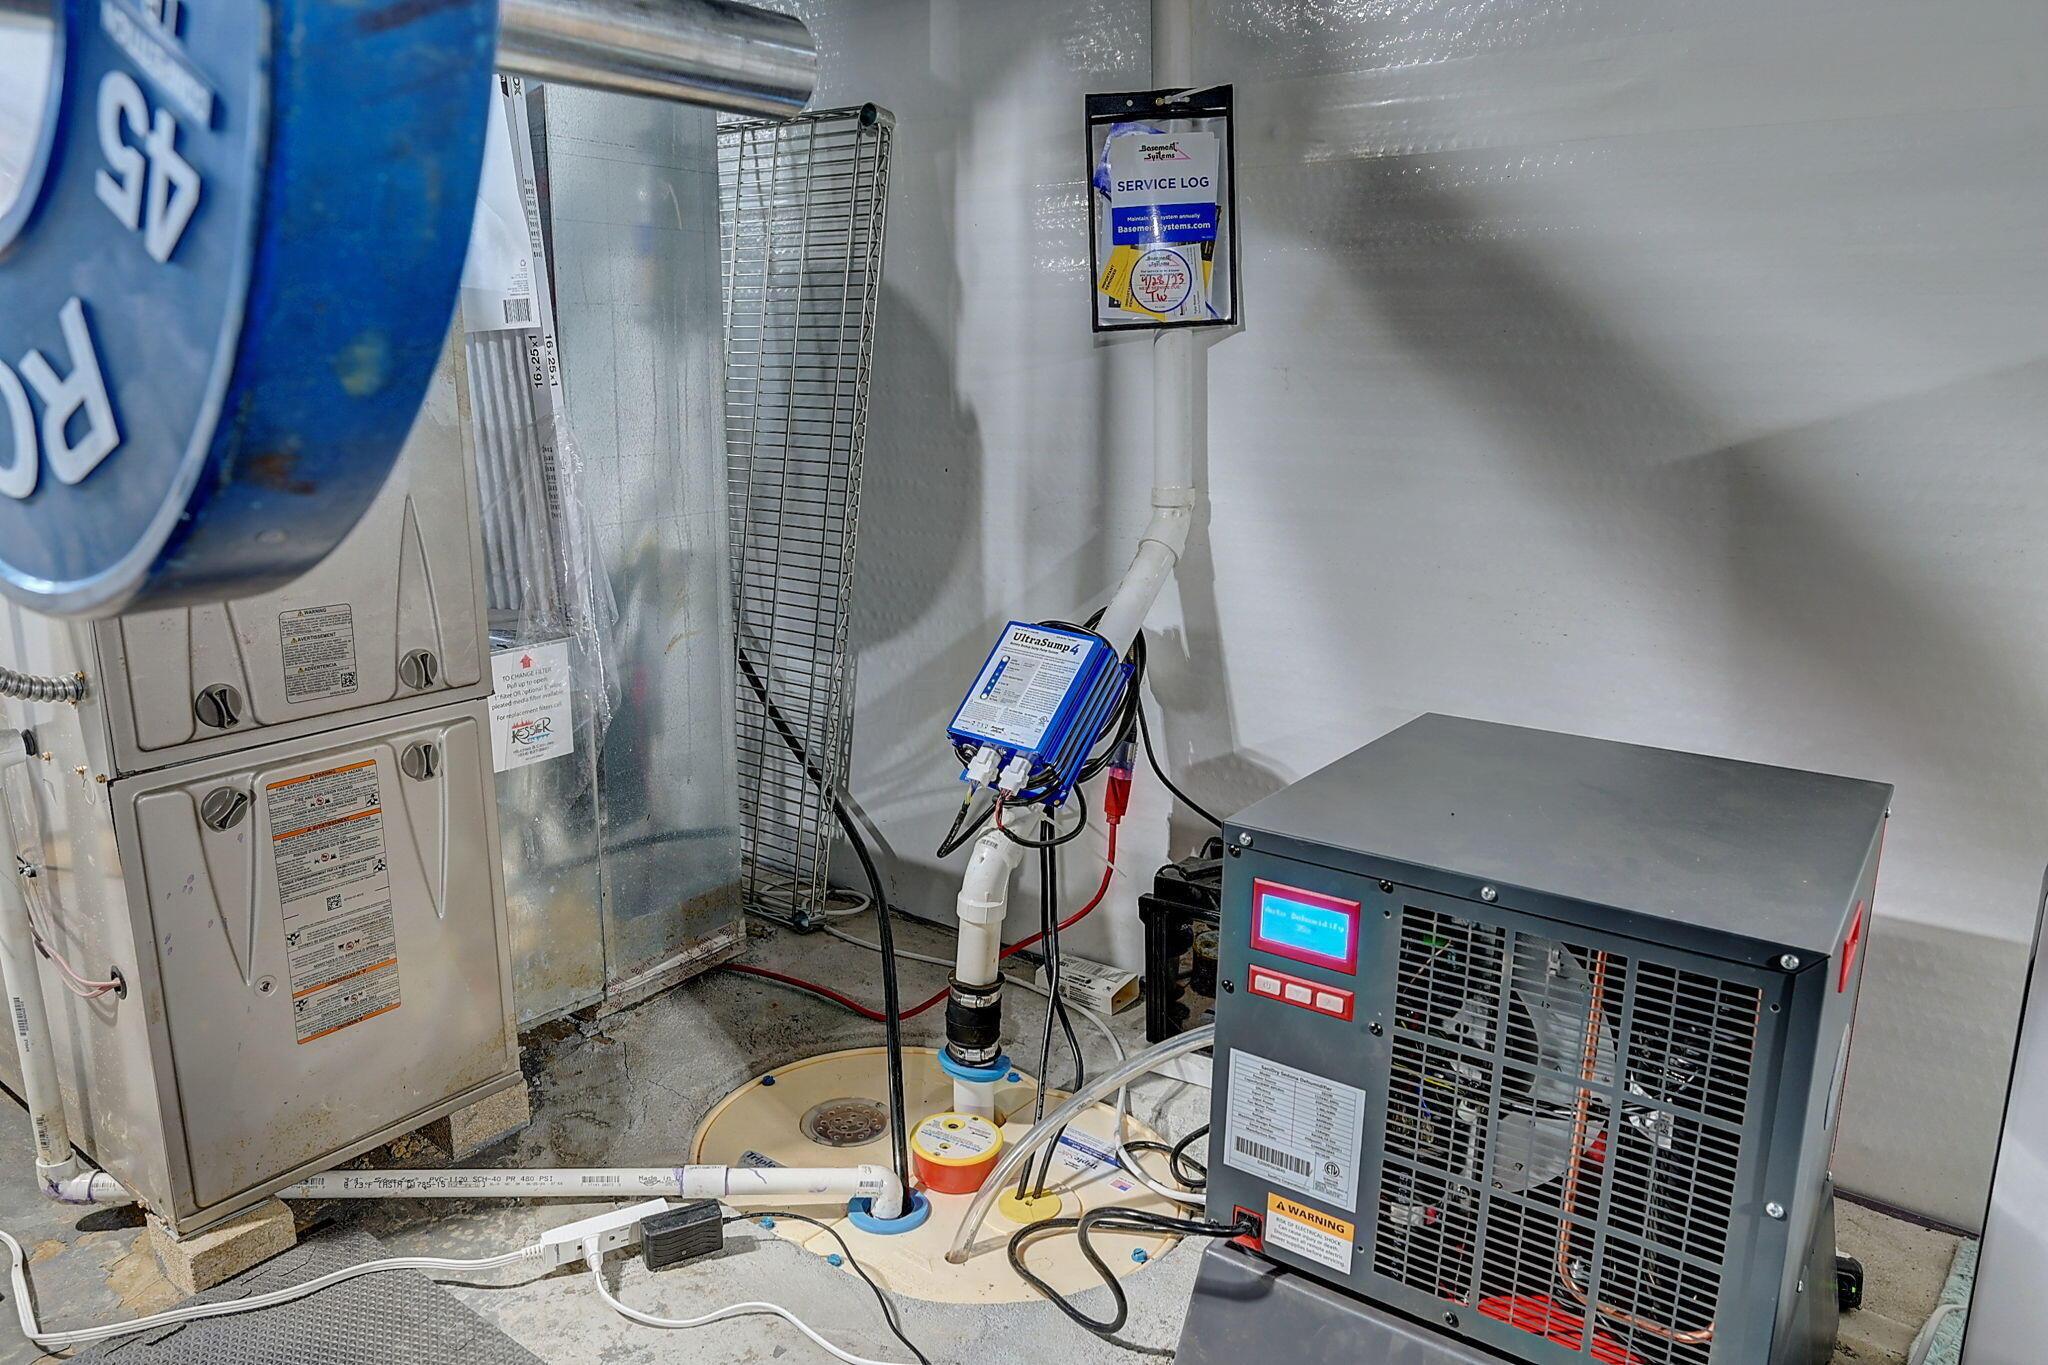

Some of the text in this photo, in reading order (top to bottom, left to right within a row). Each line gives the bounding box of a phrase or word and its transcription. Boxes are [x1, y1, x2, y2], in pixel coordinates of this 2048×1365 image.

[1139, 142, 1178, 152] Basement
[1144, 151, 1175, 161] Systems
[96, 70, 201, 262] 45
[1117, 177, 1209, 192] SERVICE LOG
[1013, 632, 1081, 656] UltraSump 4
[1288, 1205, 1345, 1234] WARNING
[1295, 1224, 1324, 1239] ELECTRICAL
